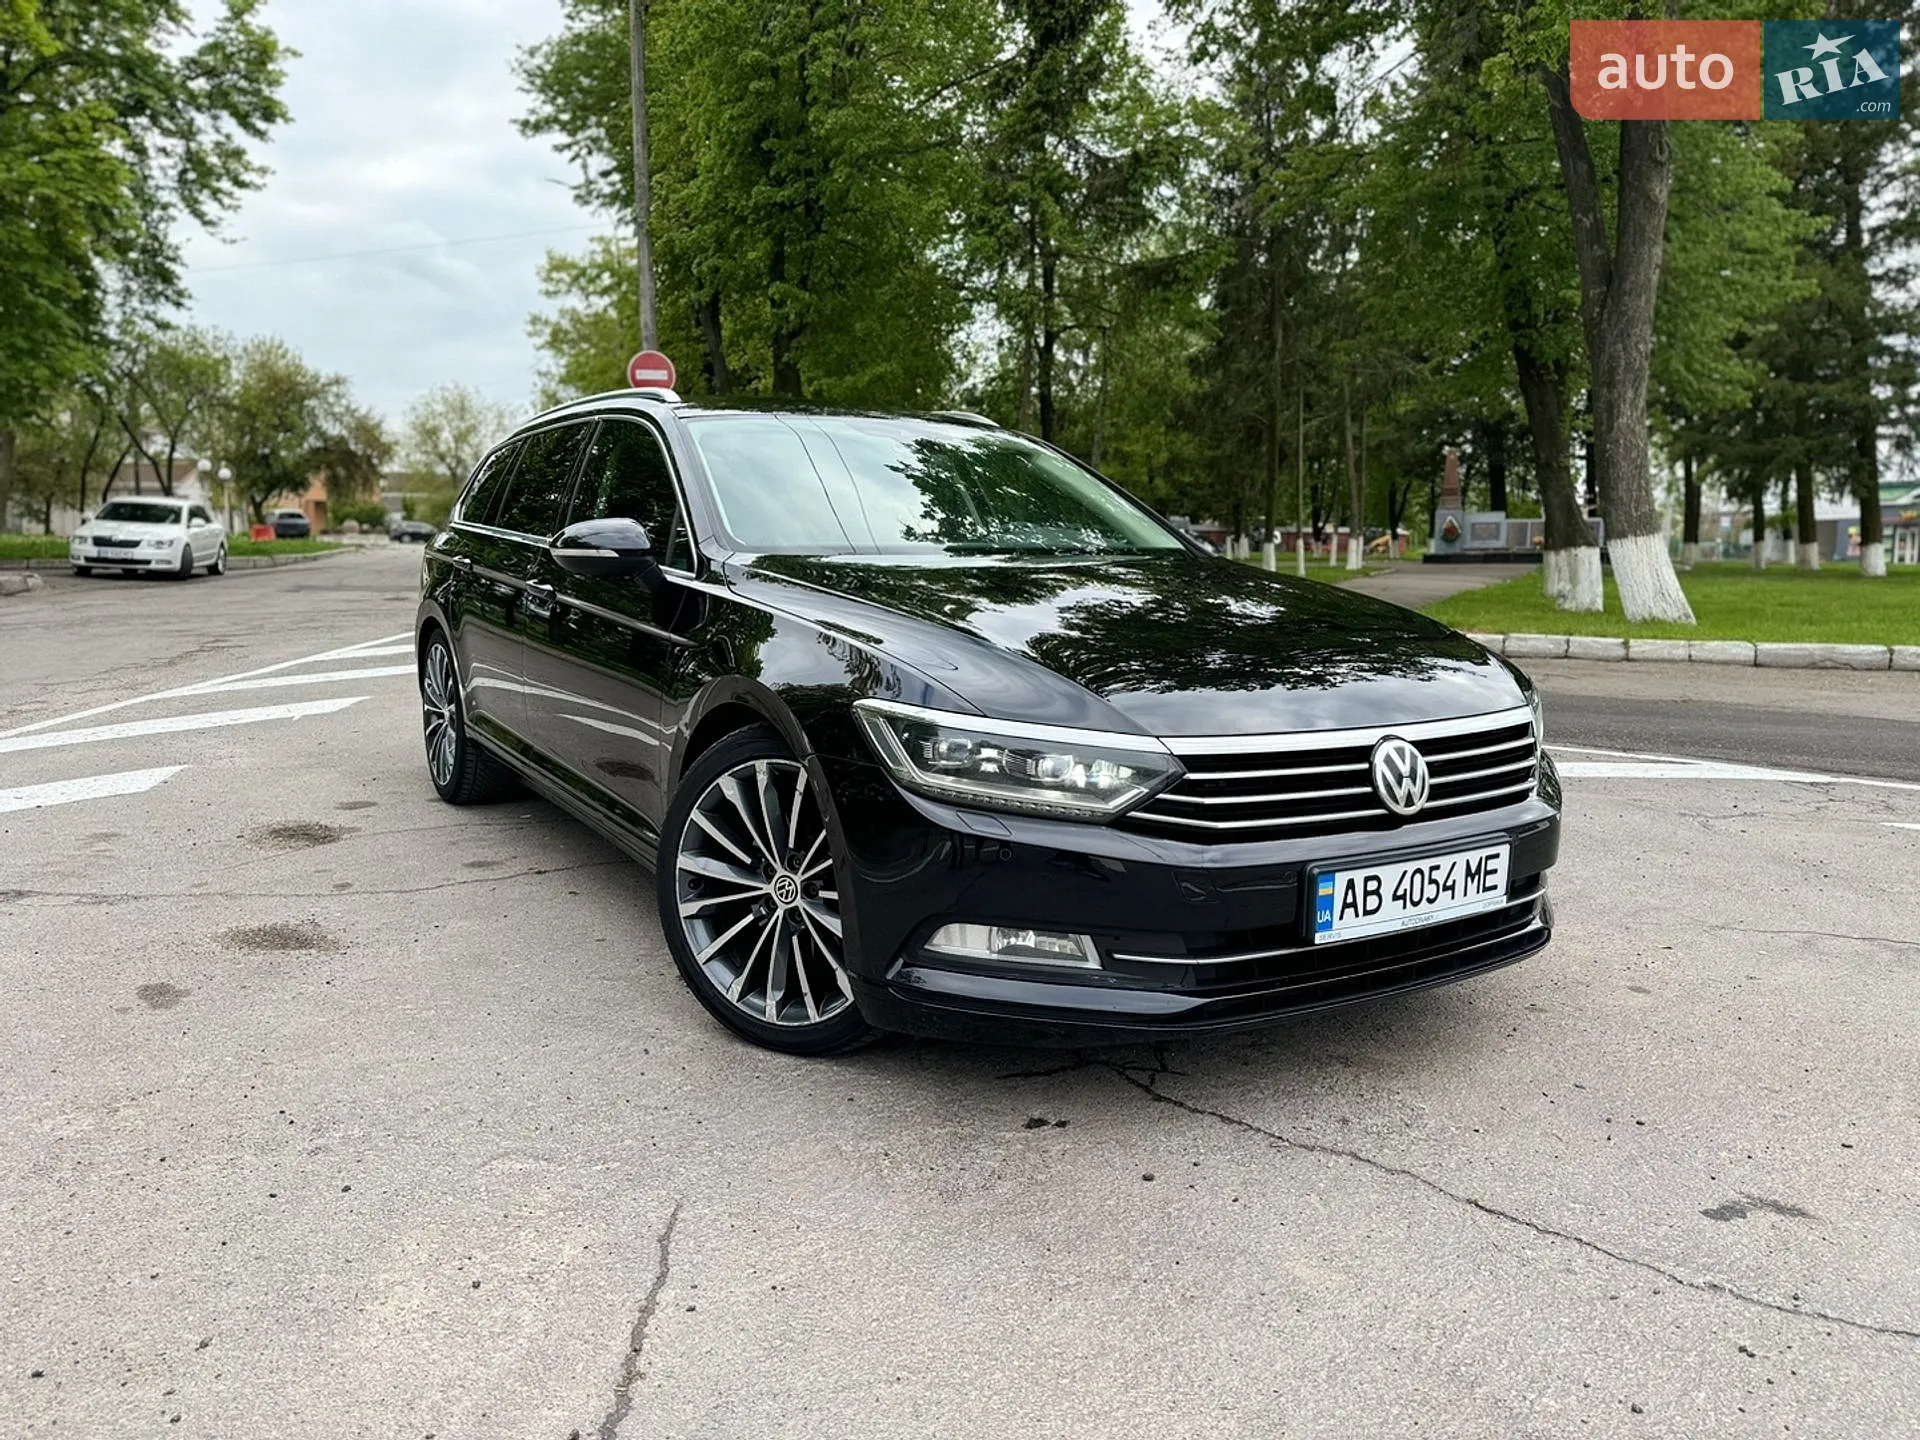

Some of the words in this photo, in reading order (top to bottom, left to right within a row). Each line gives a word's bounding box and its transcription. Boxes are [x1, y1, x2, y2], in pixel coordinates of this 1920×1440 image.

[1338, 874, 1383, 921] AB
[1391, 861, 1457, 910] 4054
[1463, 852, 1500, 897] ME
[1316, 908, 1332, 924] UA
